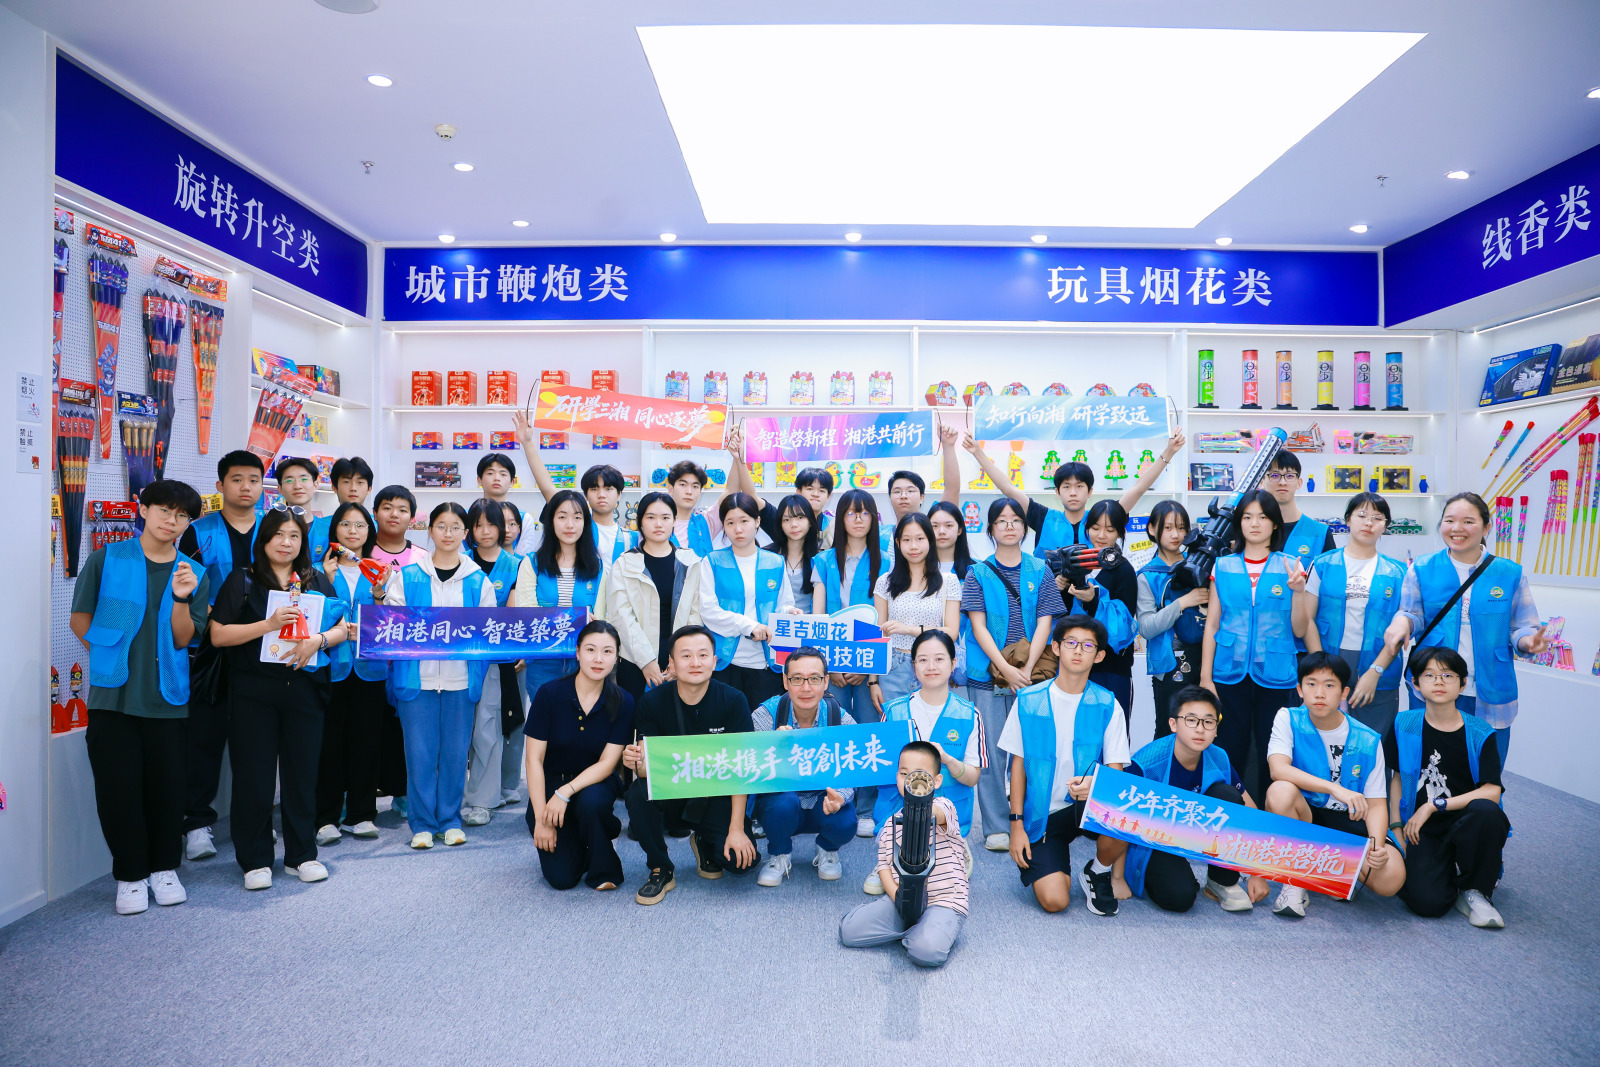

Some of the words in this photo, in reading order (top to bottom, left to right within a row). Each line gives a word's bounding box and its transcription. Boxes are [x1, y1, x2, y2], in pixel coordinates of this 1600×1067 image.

[174, 154, 320, 276] 旋转升空类
[1482, 185, 1591, 270] 线香类
[405, 263, 629, 304] 城市鞭炮类
[1047, 265, 1272, 307] 玩具烟花类
[843, 421, 925, 448] 湘港共前行
[984, 404, 1066, 429] 知行向湘
[1071, 405, 1156, 431] 研学致远
[375, 617, 476, 644] 湘港同心
[482, 613, 576, 651] 智造築夢
[775, 619, 848, 641] 星吉烟花
[1116, 784, 1230, 834] 少年齐聚力
